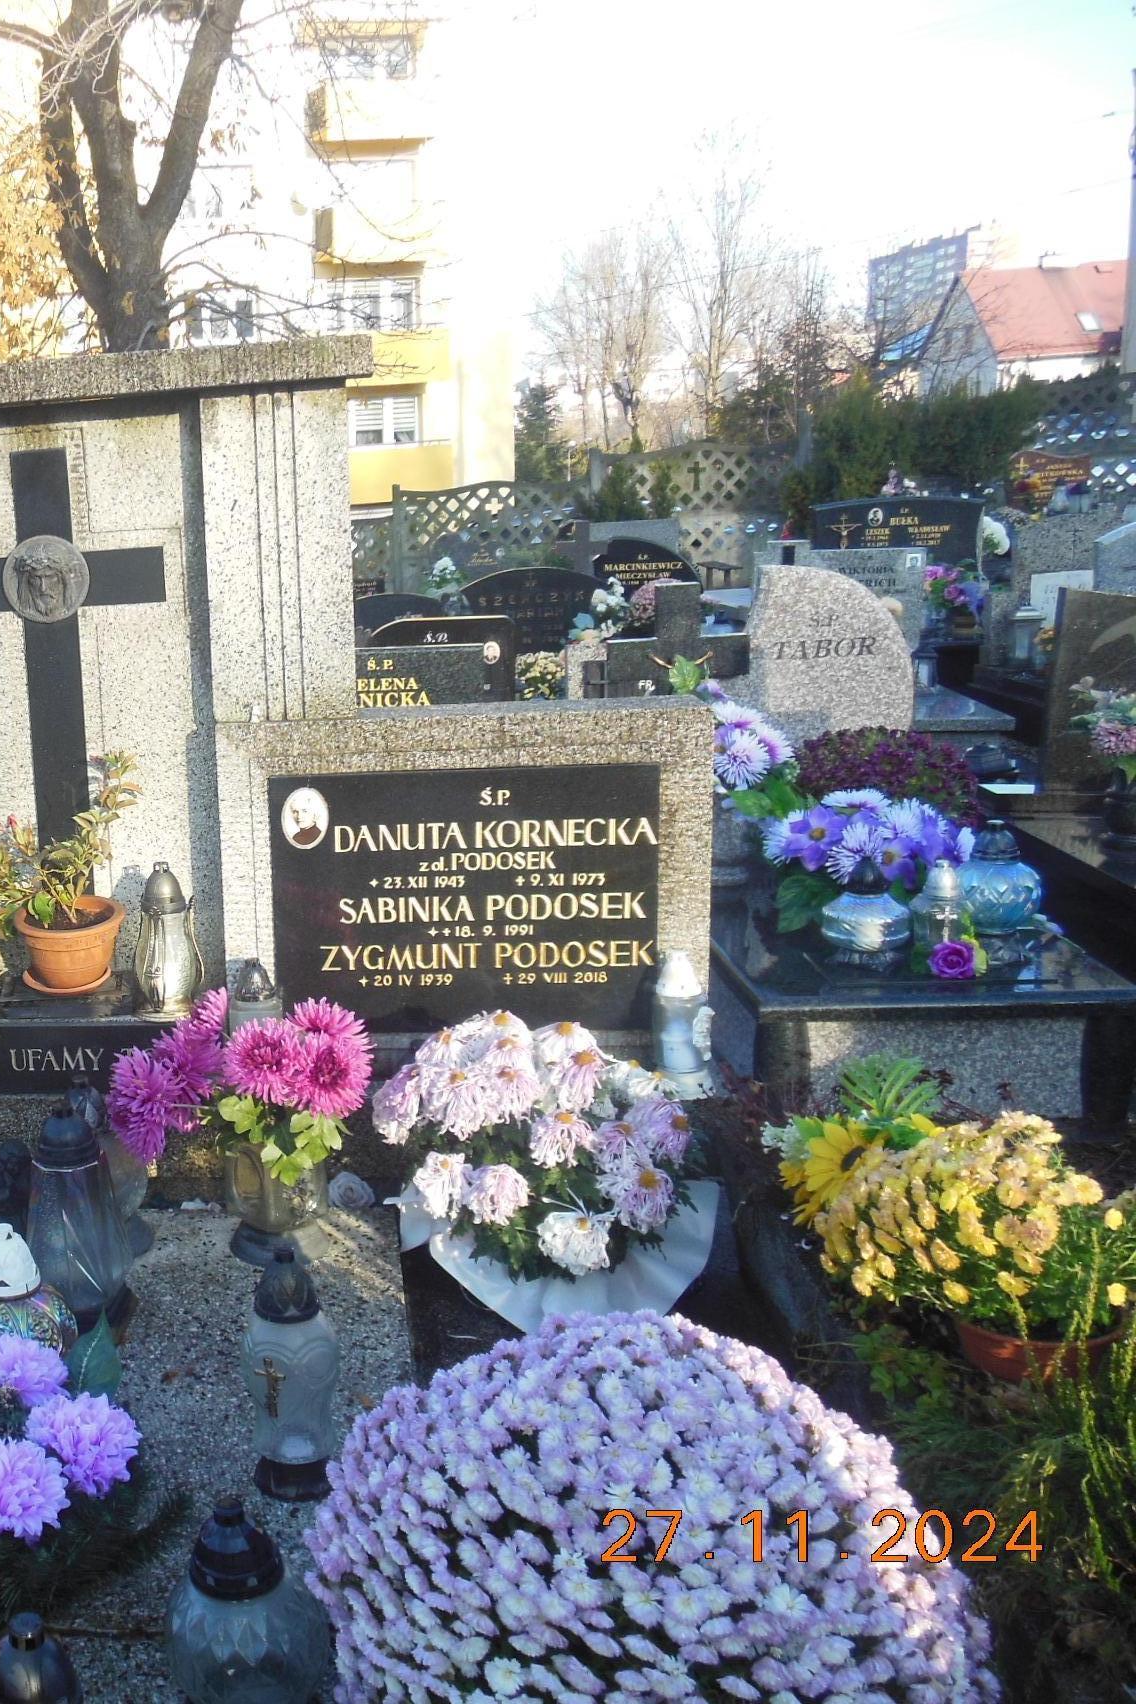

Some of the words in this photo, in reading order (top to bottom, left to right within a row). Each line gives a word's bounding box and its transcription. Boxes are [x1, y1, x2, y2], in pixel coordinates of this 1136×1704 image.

[604, 561, 683, 571] MARCINKIEWICZ
[773, 636, 878, 661] TABOR
[356, 677, 419, 692] ELENA
[356, 690, 431, 708] NICKA
[334, 821, 468, 853] DANUTA
[475, 817, 659, 849] KORNECKA
[434, 875, 466, 889] 1943
[572, 872, 606, 887] 1973
[339, 894, 476, 925] SABINKA
[486, 891, 647, 921] PODOSEK
[505, 924, 535, 936] 1991
[320, 943, 482, 972] ZYGMUNT
[494, 940, 655, 970] PODOSEK
[373, 975, 392, 987] 20
[399, 975, 412, 987] IV
[420, 974, 454, 987] 1939
[517, 973, 537, 985] 29
[543, 972, 568, 985] VIII
[574, 972, 608, 984] 2018
[10, 1046, 105, 1072] UFAMY
